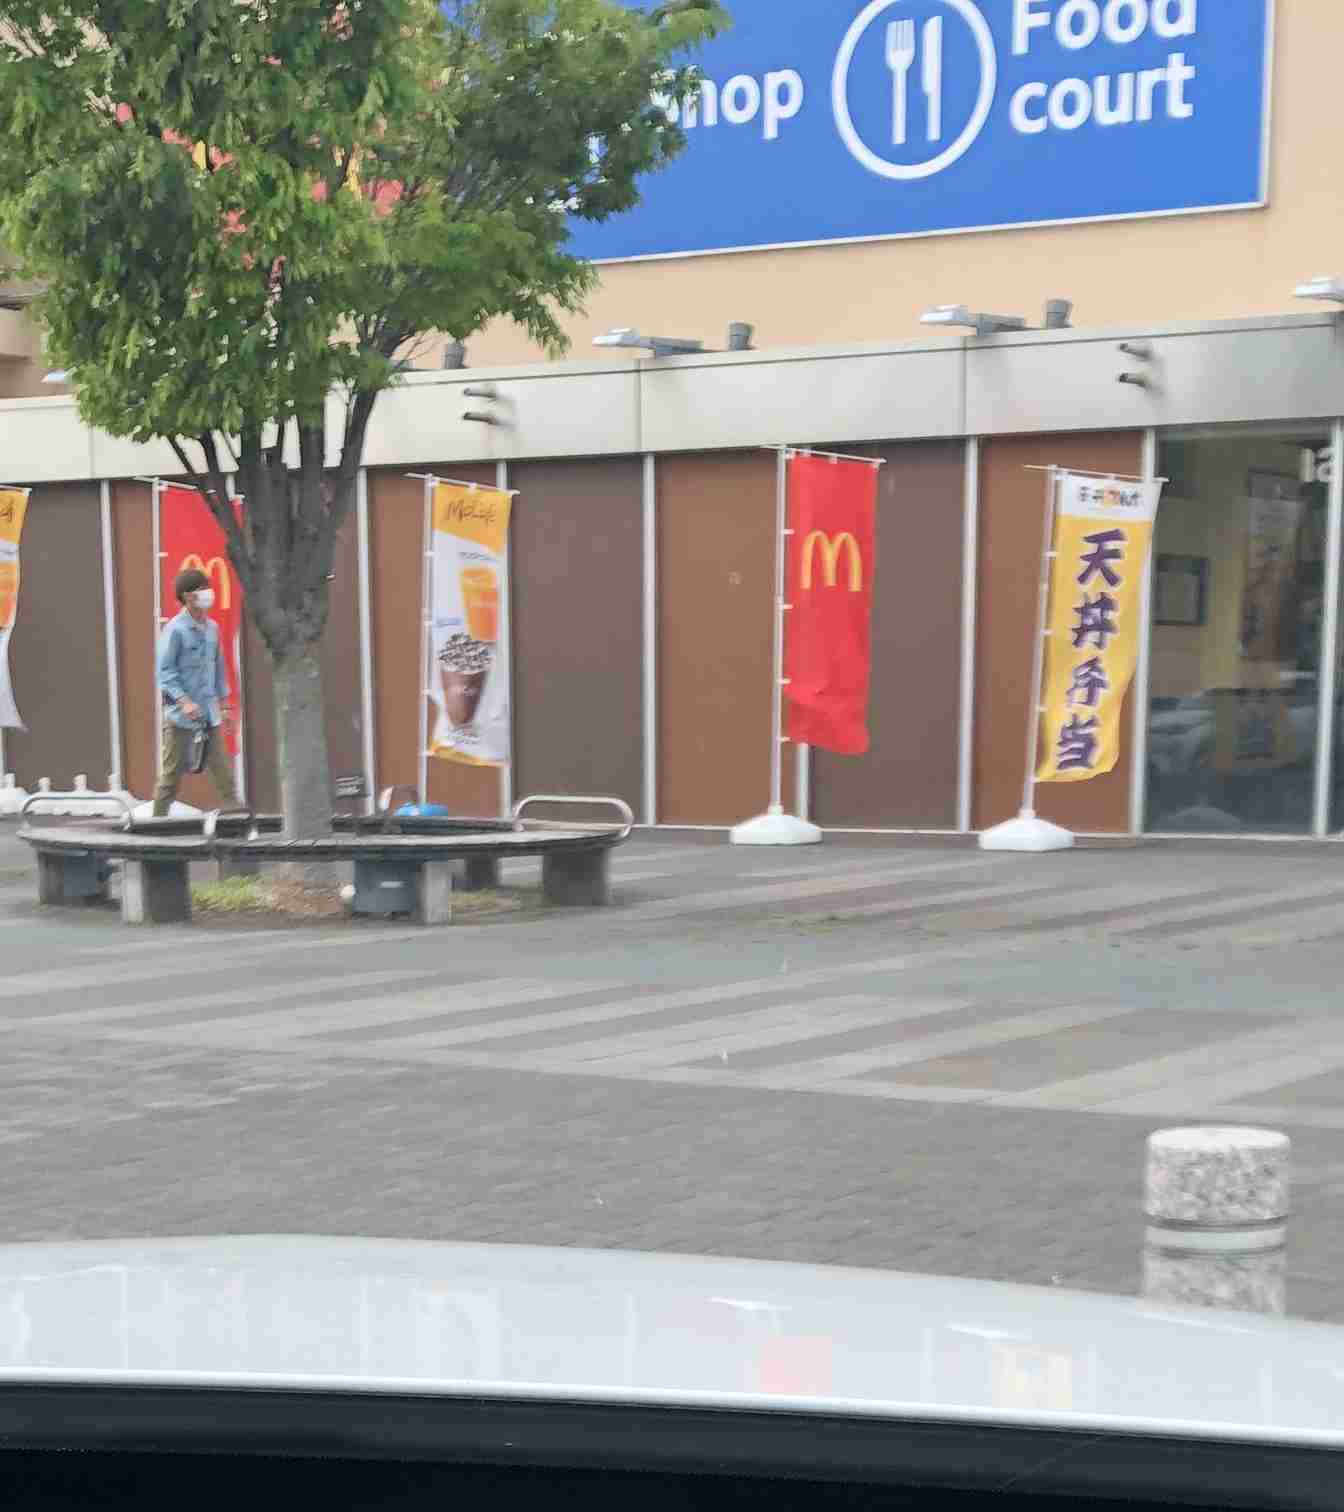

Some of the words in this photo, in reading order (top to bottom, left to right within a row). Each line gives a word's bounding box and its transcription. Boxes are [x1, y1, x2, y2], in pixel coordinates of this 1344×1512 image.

[1012, 0, 1196, 55] Food
[1009, 52, 1196, 134] court
[1057, 527, 1129, 771] 天丼弁当
